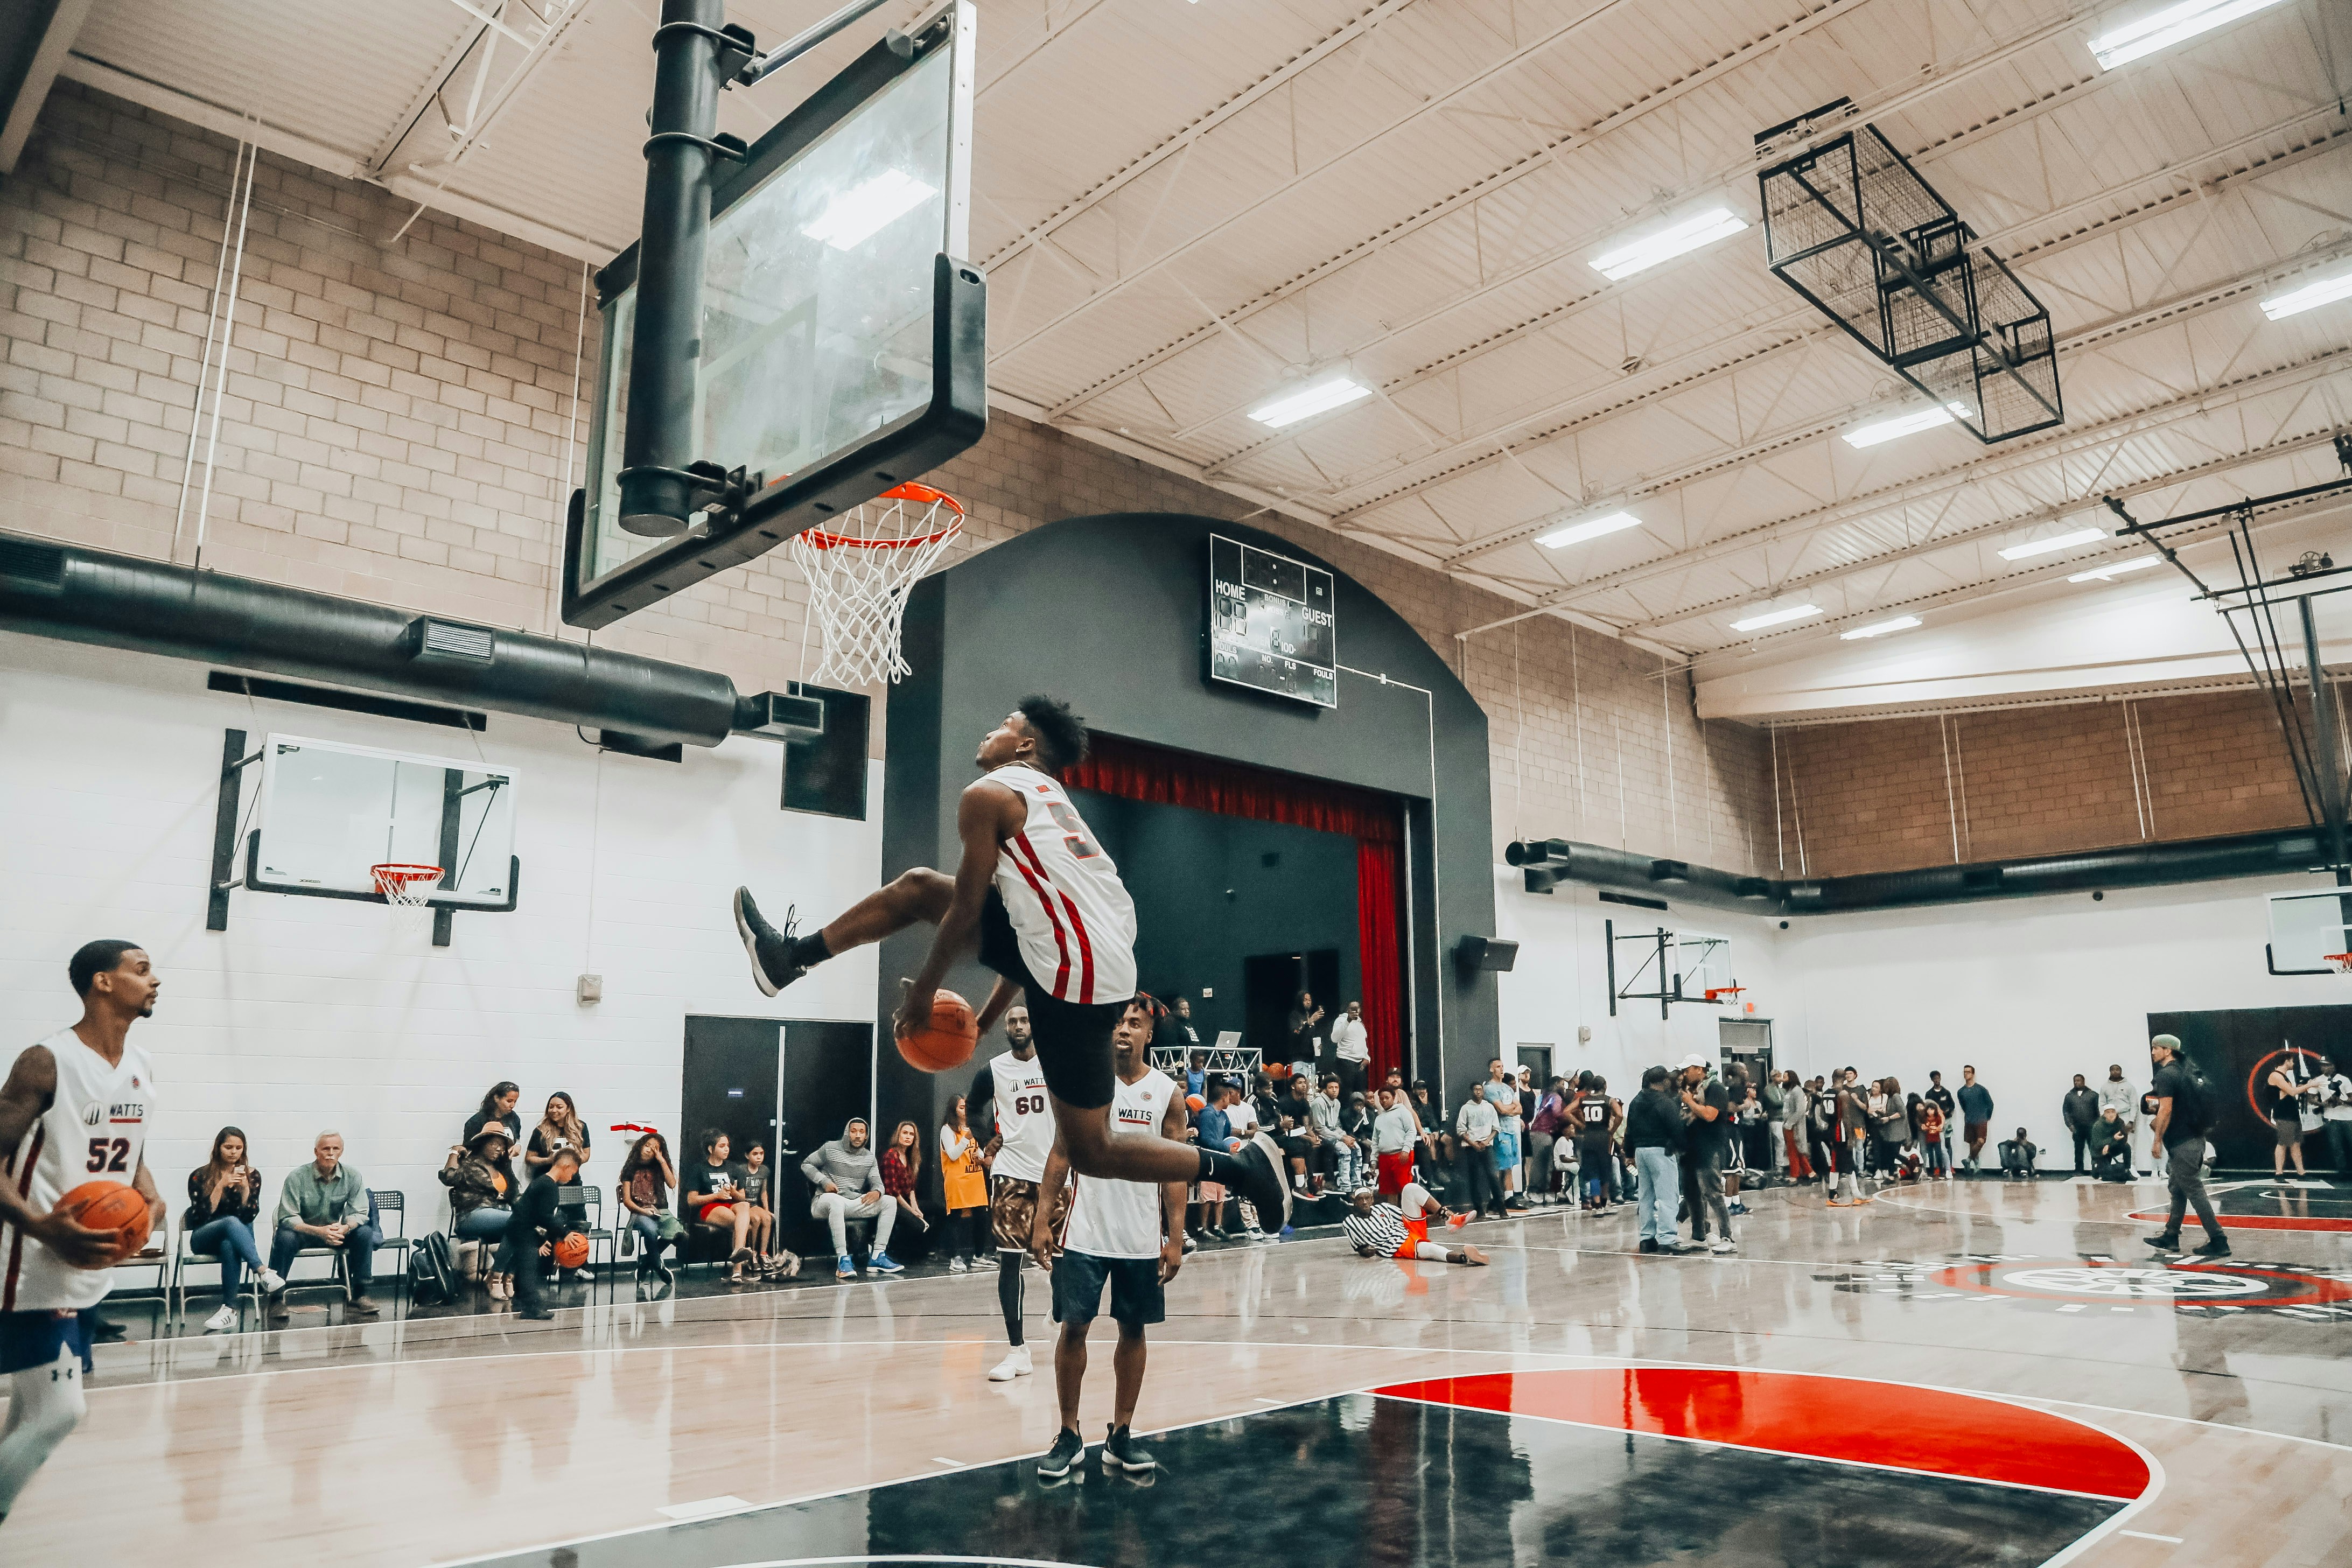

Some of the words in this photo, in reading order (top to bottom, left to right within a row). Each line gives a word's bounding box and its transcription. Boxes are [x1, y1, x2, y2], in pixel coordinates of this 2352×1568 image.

[1215, 579, 1245, 601] HOME
[1264, 594, 1286, 606] BONUS
[1301, 606, 1332, 627] GUEST
[1284, 661, 1297, 670] FLS
[1313, 668, 1333, 680] FOULS
[1024, 1077, 1045, 1086] WATT
[110, 1104, 143, 1117] WATTS
[1015, 1095, 1045, 1115] 60
[1118, 1108, 1152, 1121] WATTS
[1583, 1106, 1603, 1122] 10
[87, 1137, 130, 1173] 52
